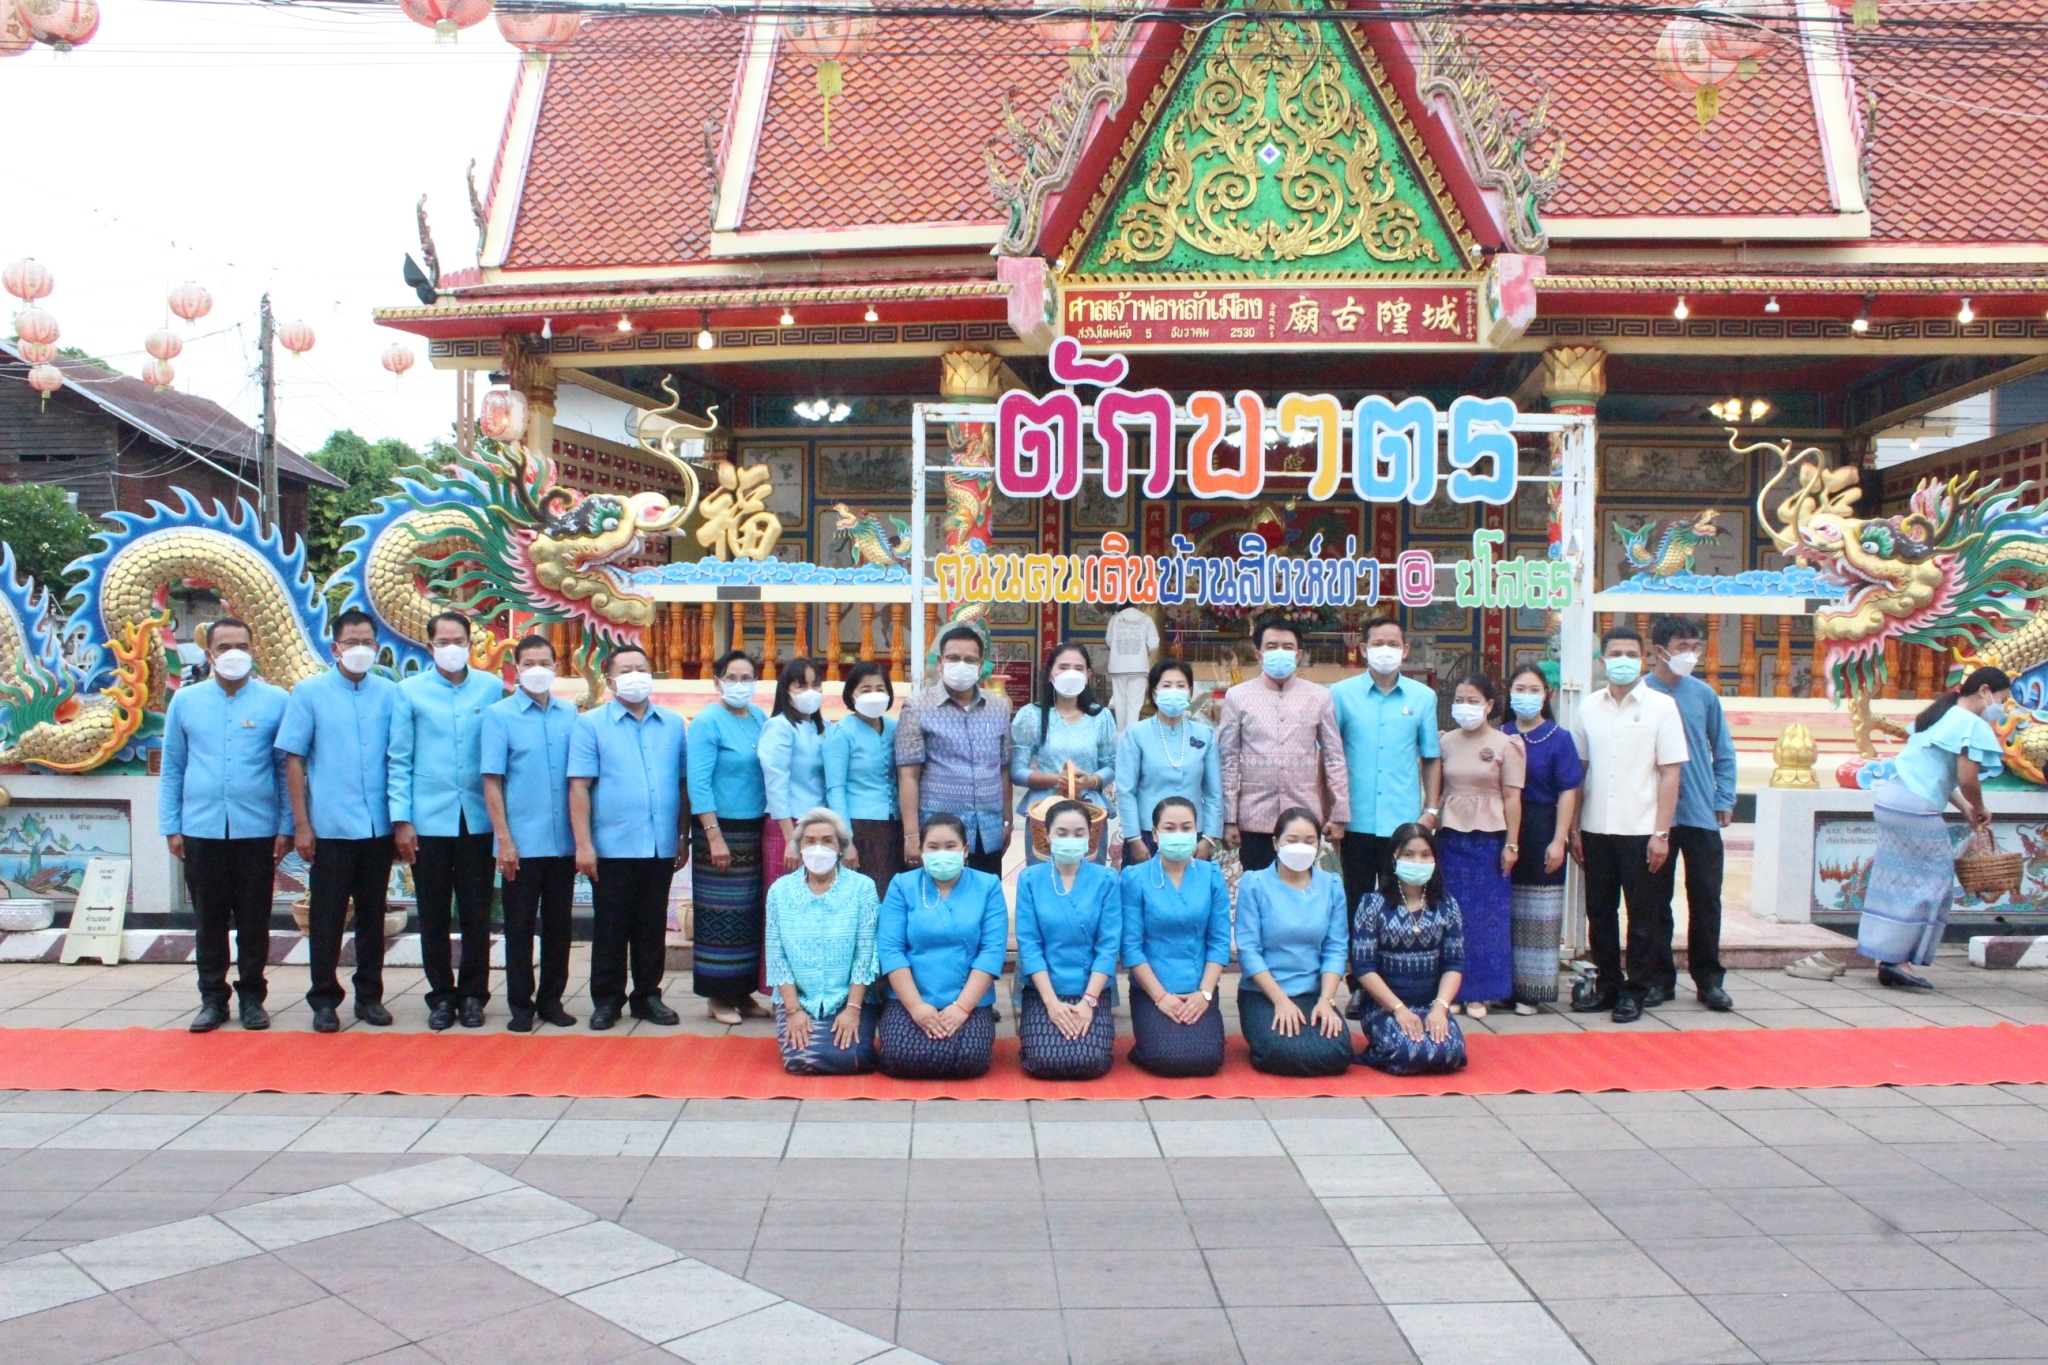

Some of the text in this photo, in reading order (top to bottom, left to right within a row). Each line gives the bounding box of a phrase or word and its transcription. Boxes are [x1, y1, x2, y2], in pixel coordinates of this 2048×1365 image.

[1068, 291, 1263, 322] ศาลเจ้าพ่อหลักเมือง
[1145, 328, 1152, 339] 5
[1171, 326, 1209, 339] ธันวาคม
[1230, 327, 1255, 338] 2530
[996, 336, 1518, 504] ตักบาตร
[1398, 550, 1434, 606] @
[1455, 528, 1573, 608] ยโสธร
